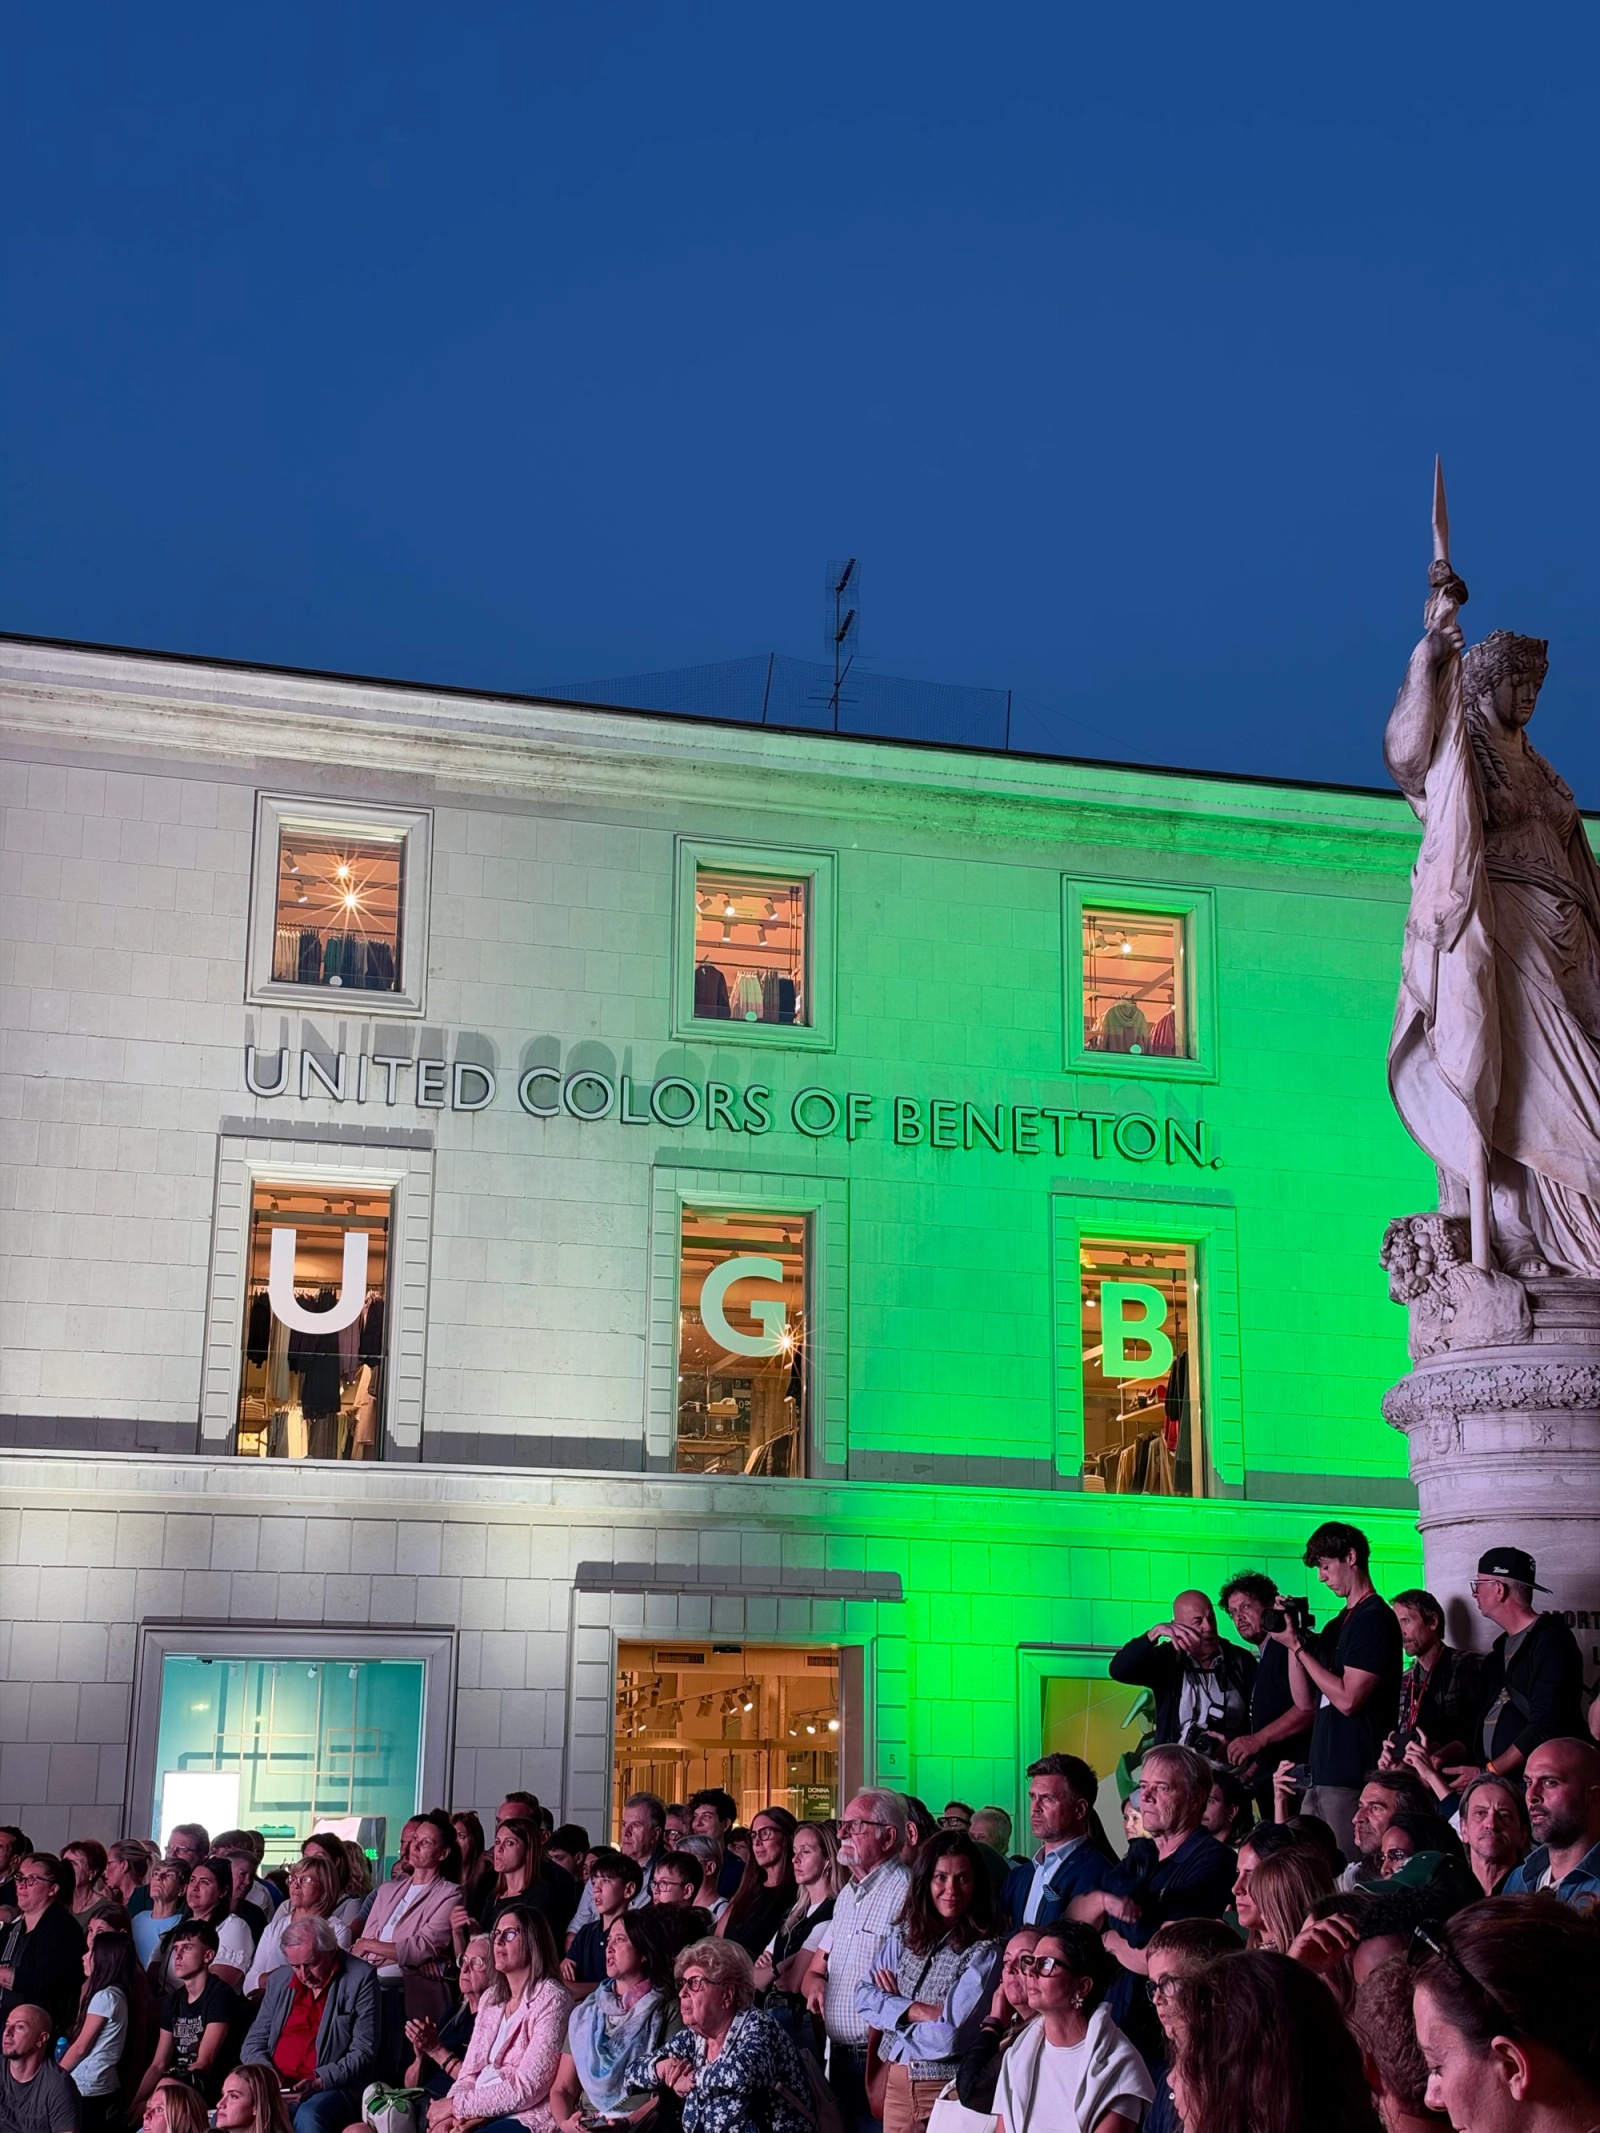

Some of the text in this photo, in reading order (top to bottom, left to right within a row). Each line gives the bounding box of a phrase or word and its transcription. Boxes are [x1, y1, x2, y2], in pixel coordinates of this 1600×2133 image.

[245, 1045, 1224, 1170] UNITED COLORS OF BENETTON.
[268, 1228, 369, 1335] U
[700, 1256, 787, 1357] G
[1100, 1281, 1174, 1379] B
[889, 1753, 896, 1765] 5
